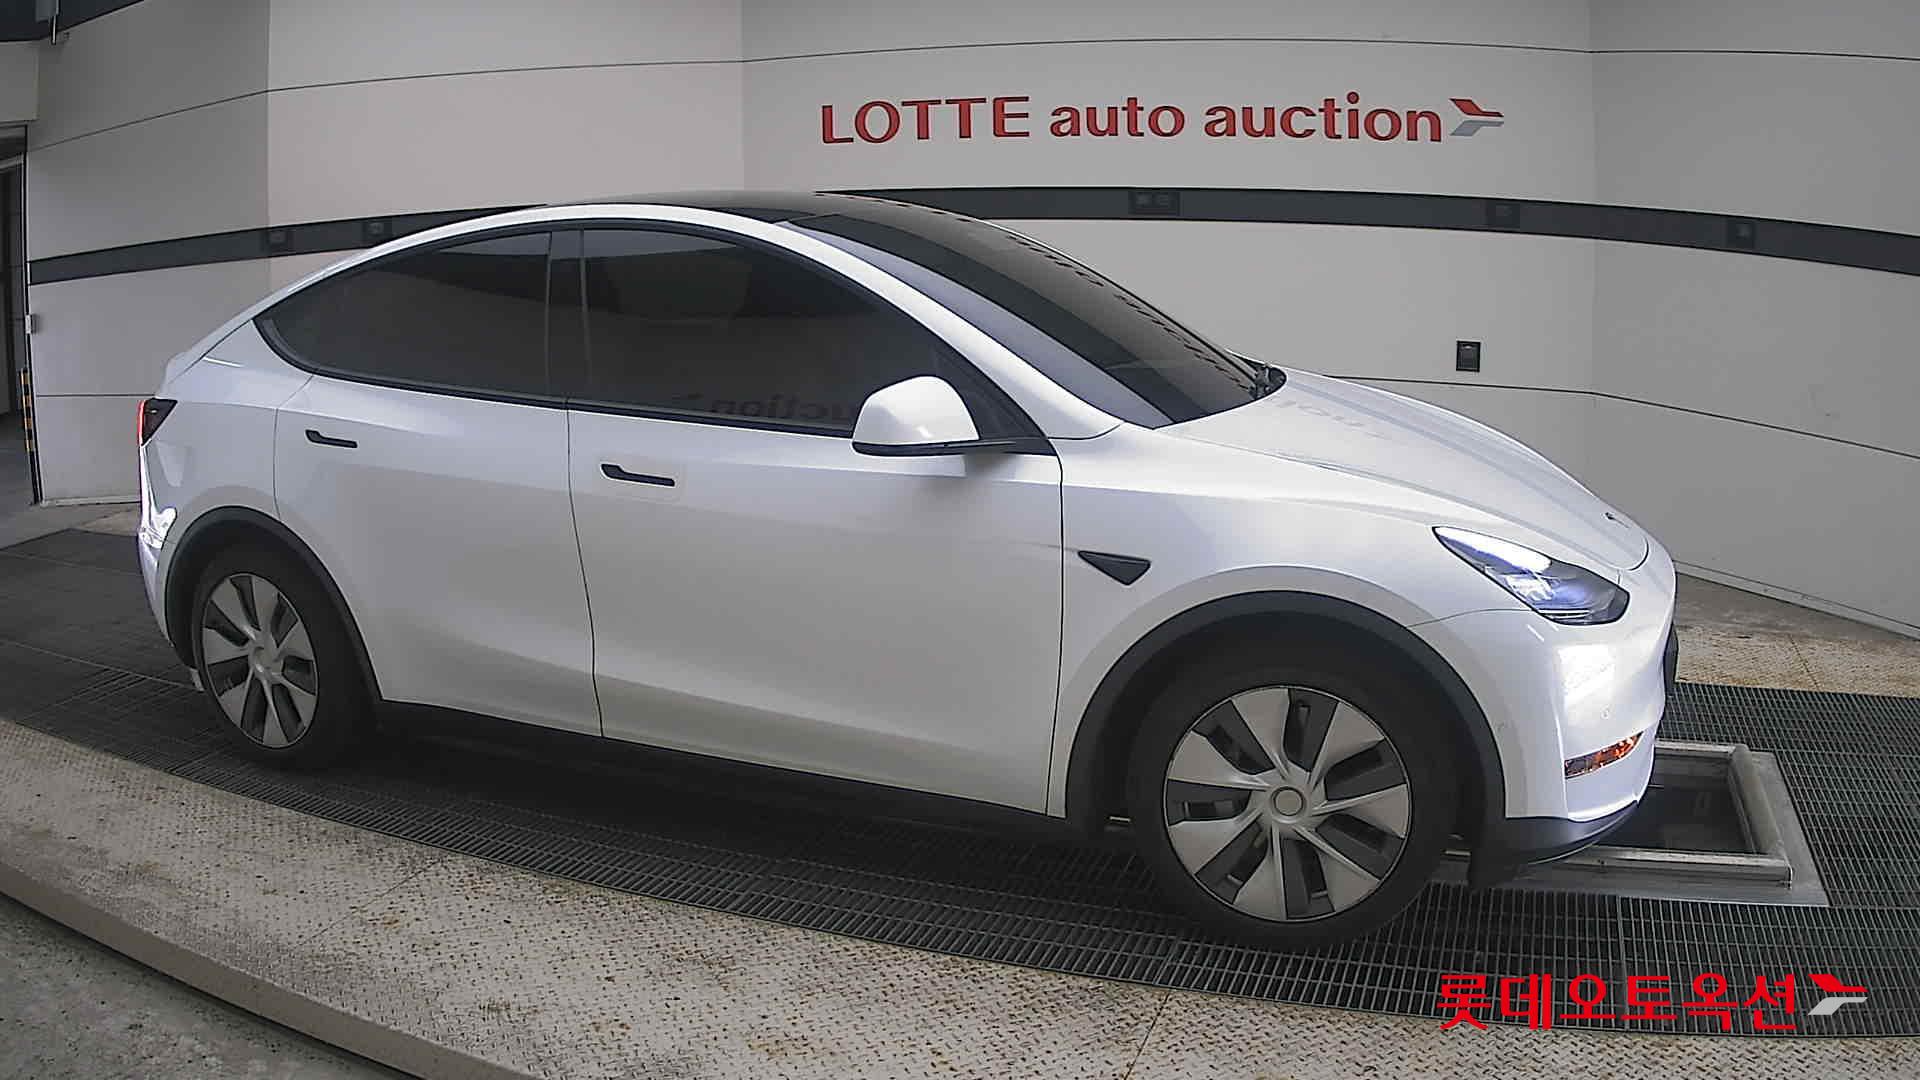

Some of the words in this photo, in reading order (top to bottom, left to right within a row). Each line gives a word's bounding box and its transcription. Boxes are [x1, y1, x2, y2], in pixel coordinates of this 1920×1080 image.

[820, 96, 1030, 144] LOTTE
[1050, 97, 1185, 138] auto
[1203, 91, 1443, 142] auction
